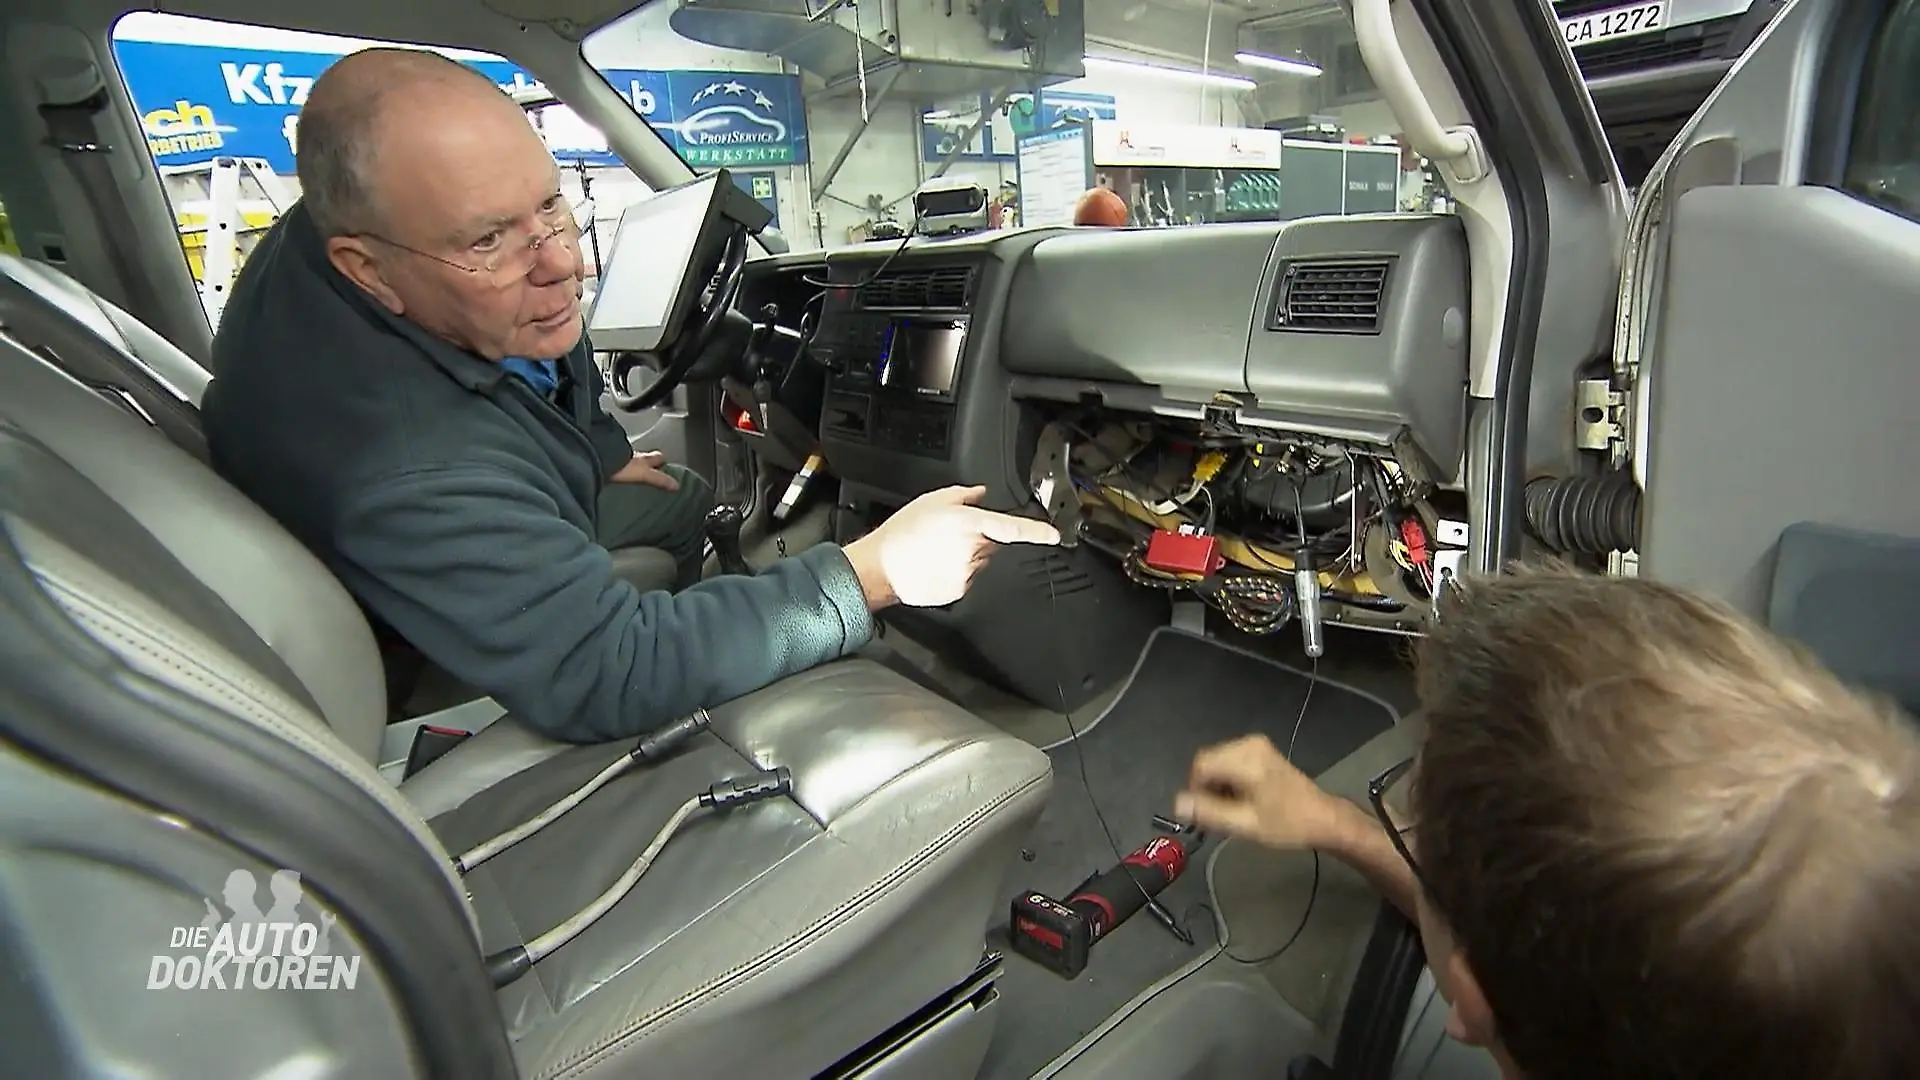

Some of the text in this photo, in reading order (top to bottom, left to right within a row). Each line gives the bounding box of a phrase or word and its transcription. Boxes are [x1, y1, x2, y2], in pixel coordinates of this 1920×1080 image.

[1565, 5, 1661, 42] CA 1272
[219, 62, 315, 106] Kfz
[685, 147, 788, 162] WERKSTATT
